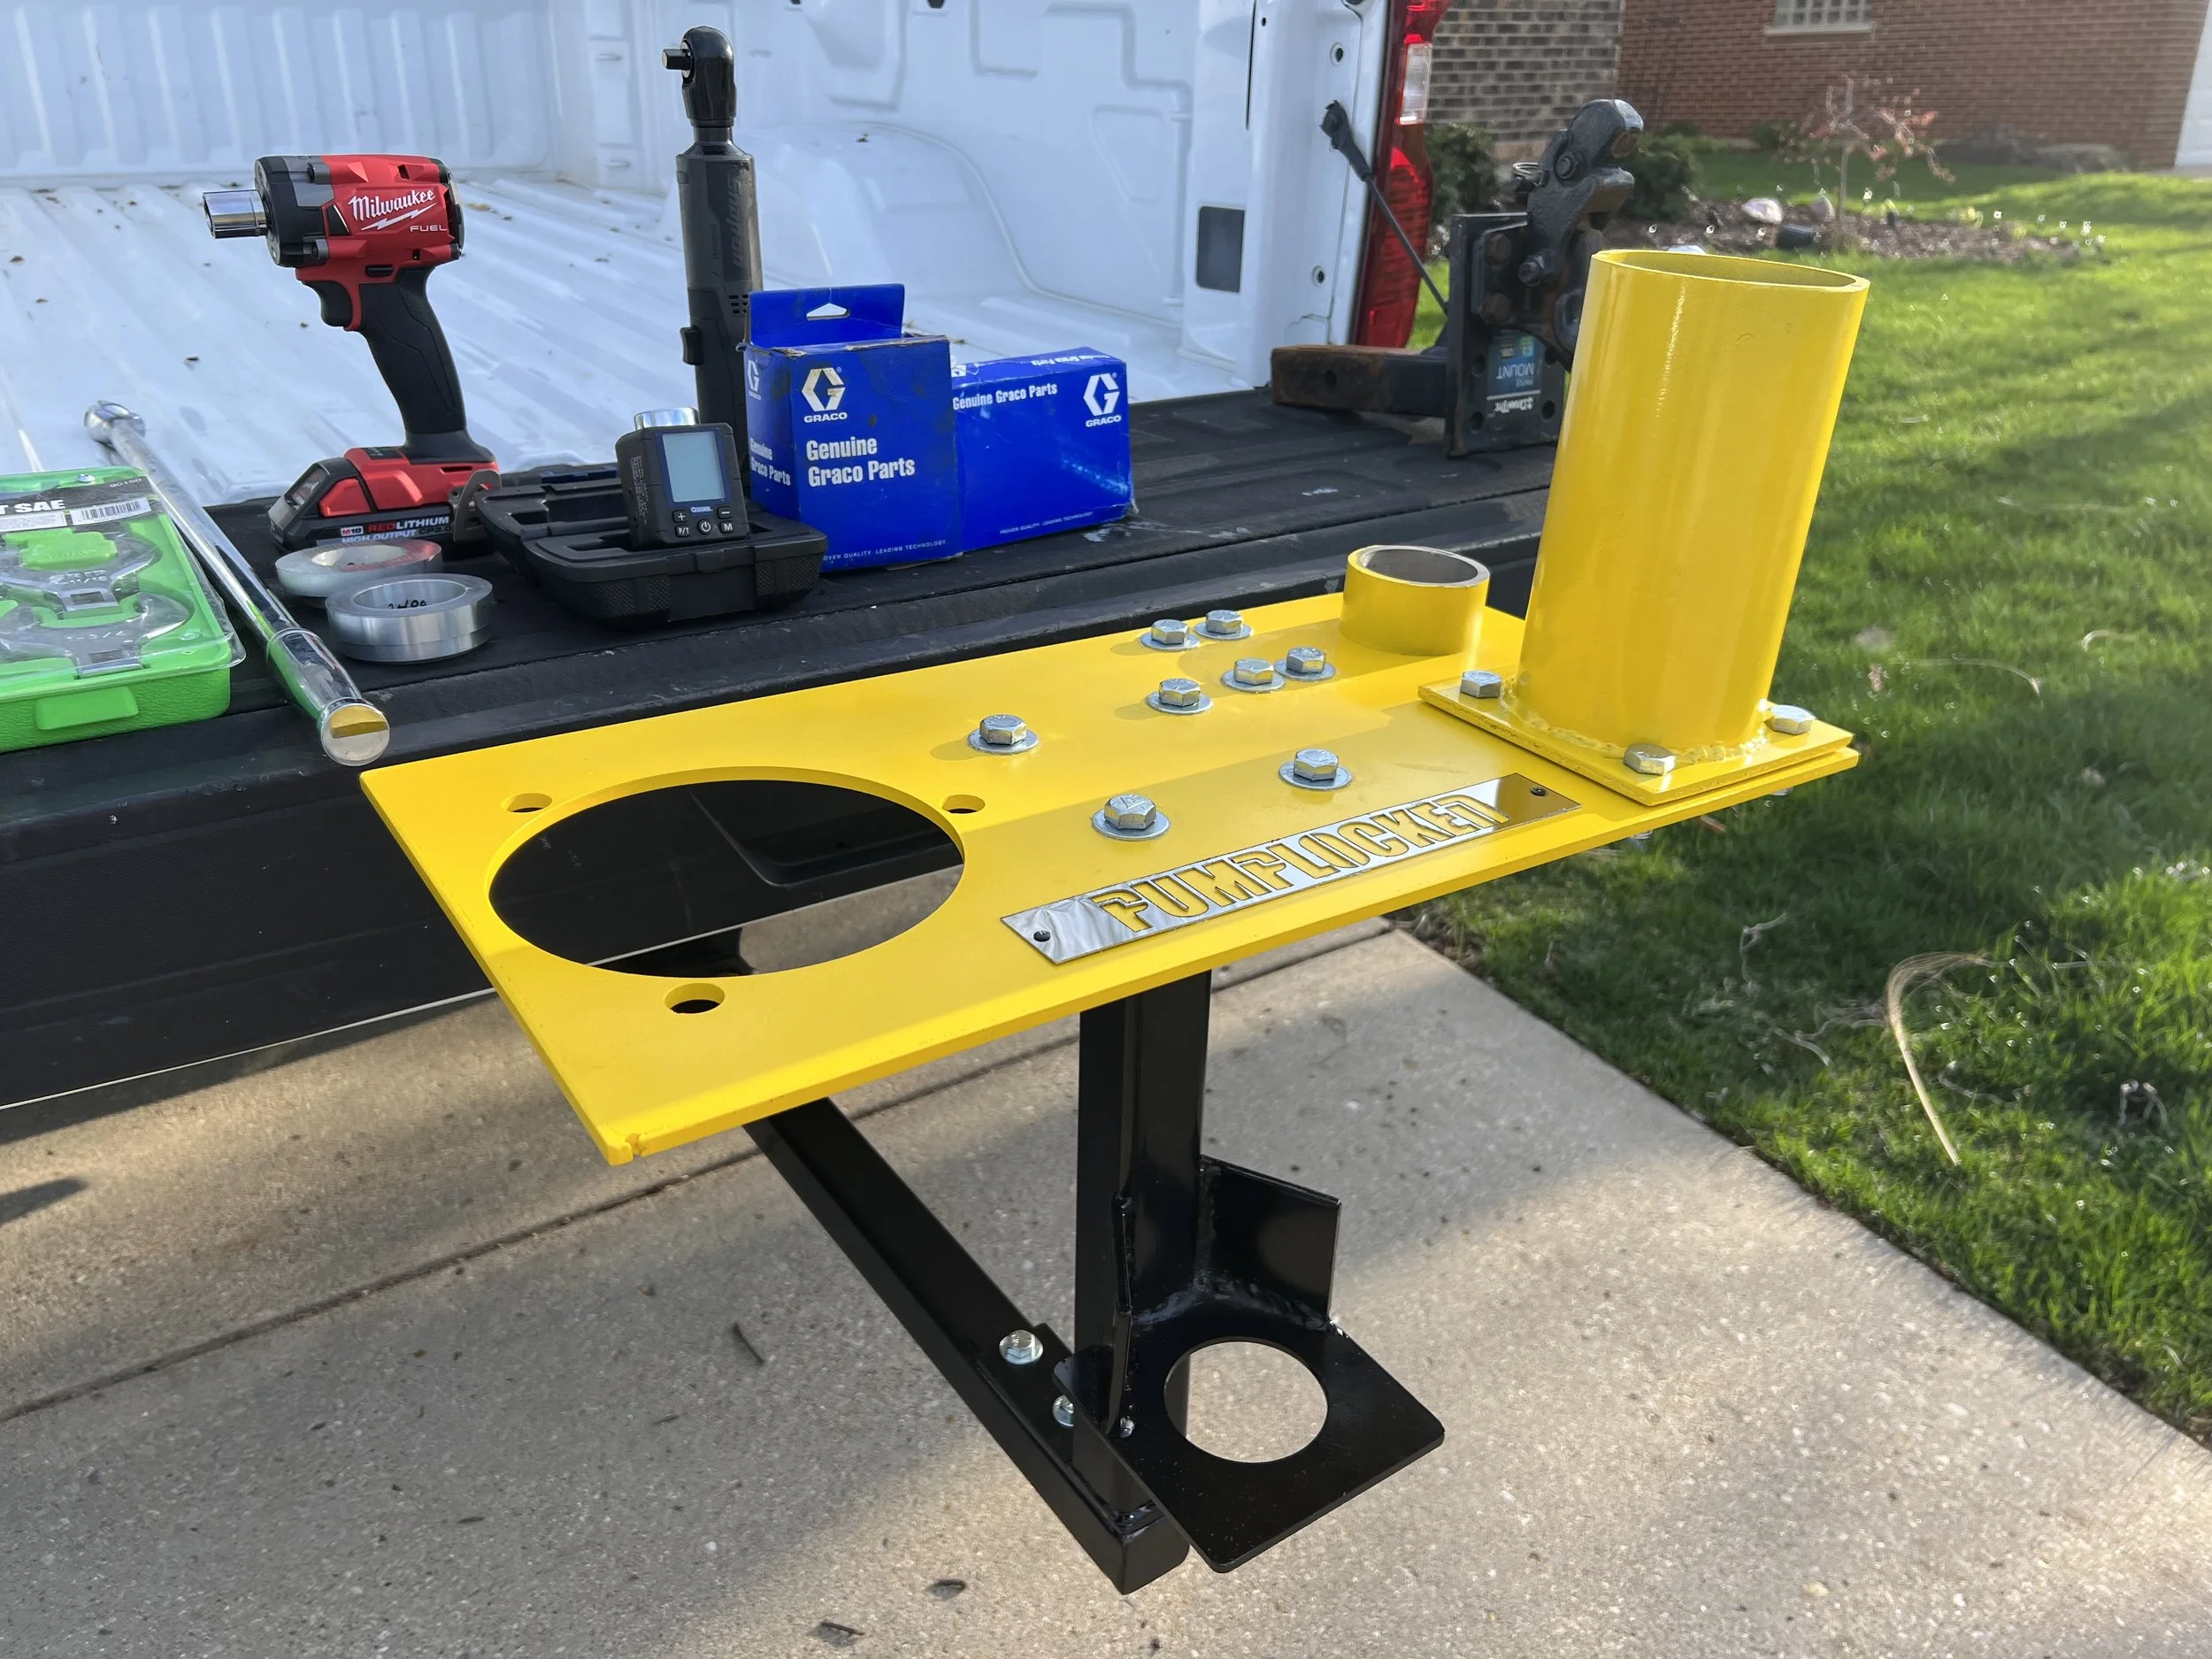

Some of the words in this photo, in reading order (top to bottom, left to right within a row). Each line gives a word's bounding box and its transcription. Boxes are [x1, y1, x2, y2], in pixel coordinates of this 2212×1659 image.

[348, 190, 436, 220] Milwaukee
[1495, 362, 1535, 380] MOUNT
[953, 393, 993, 411] Genuine
[995, 388, 1027, 403] Graco
[1029, 383, 1057, 397] Parts
[803, 412, 848, 423] GRACO
[1086, 415, 1122, 427] GRACO
[806, 436, 878, 461] Genuine
[769, 465, 791, 487] Parts
[808, 465, 864, 488] Graco
[868, 457, 915, 480] Parts
[14, 499, 66, 513] SAE
[342, 526, 363, 535] M18
[368, 516, 449, 532] REDLITHIUM
[723, 523, 733, 532] M
[342, 534, 370, 542] HIGH
[373, 529, 417, 541] OUTPUT
